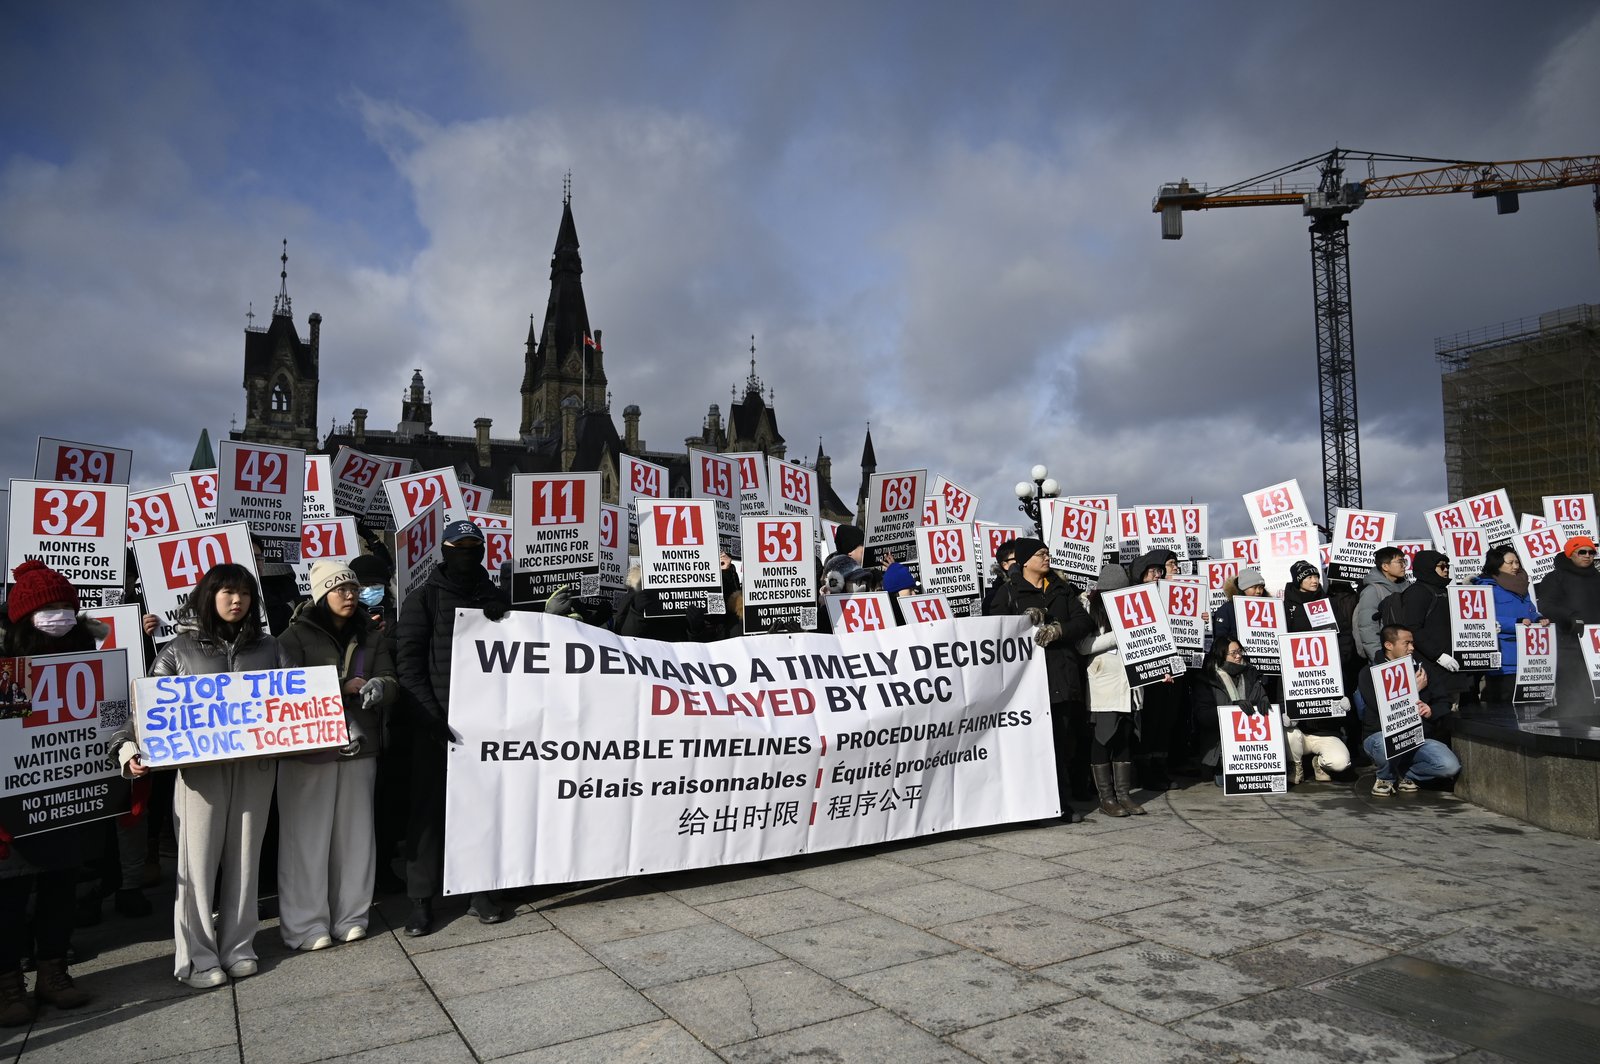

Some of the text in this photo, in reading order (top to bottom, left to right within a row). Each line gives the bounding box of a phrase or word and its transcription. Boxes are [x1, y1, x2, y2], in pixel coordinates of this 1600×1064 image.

[62, 449, 108, 483] 39
[240, 451, 281, 493] 42
[343, 457, 376, 485] 25
[338, 482, 363, 495] MONTHS
[634, 464, 657, 496] 34
[706, 460, 728, 496] 15
[785, 467, 807, 502] 53
[241, 496, 282, 508] MONTHS
[353, 494, 366, 504] FOR
[540, 482, 576, 524] 11
[885, 478, 912, 511] 68
[944, 487, 966, 517] 33
[1260, 490, 1288, 515] 43
[41, 490, 97, 535] 32
[229, 508, 291, 520] WAITING FOR
[724, 512, 735, 521] FOR
[785, 503, 808, 514] MONTHS
[882, 513, 909, 522] MONTHS
[1268, 512, 1293, 524] MONTHS
[1474, 497, 1497, 520] 27
[1558, 499, 1581, 520] 16
[660, 507, 697, 544] 71
[874, 524, 900, 533] WAITING
[1066, 509, 1092, 540] 39
[1150, 510, 1173, 534] 34
[1289, 517, 1303, 526] FOR
[1351, 516, 1380, 541] 65
[307, 525, 337, 556] 37
[411, 513, 432, 562] 31
[537, 529, 578, 540] MONTHS
[764, 523, 797, 561] 53
[869, 534, 884, 542] IRCC
[1275, 531, 1303, 554] 55
[1455, 532, 1478, 556] 72
[1488, 529, 1516, 540] RESPONSE
[1528, 532, 1557, 556] 35
[40, 541, 95, 552] MONTHS
[526, 541, 589, 554] WAITING FOR
[662, 550, 699, 559] MONTHS
[933, 531, 961, 563] 68
[1056, 550, 1095, 563] WAITING FOR
[1064, 542, 1089, 552] MONTHS
[1237, 540, 1259, 563] 30
[1339, 548, 1367, 557] WAITING
[85, 555, 109, 566] FOR
[411, 554, 432, 579] MONTHS
[520, 552, 593, 568] IRCC RESPONSE
[653, 562, 710, 572] WAITING FOR
[936, 565, 963, 575] MONTHS
[1065, 560, 1097, 572] RESPONSE
[543, 572, 584, 582] TIMELINES
[649, 573, 716, 584] IRCC RESPONSE
[763, 567, 797, 576] MONTHS
[930, 575, 970, 585] WAITING FOR
[754, 578, 806, 588] WAITING FOR
[943, 584, 975, 593] RESPONSE
[671, 591, 708, 599] TIMELINES
[750, 589, 811, 600] IRCC RESPONSE
[1172, 587, 1195, 615] 33
[1462, 591, 1484, 618] 34
[663, 601, 673, 610] NO
[846, 599, 880, 632] 34
[1123, 593, 1151, 626] 41
[1249, 602, 1274, 627] 24
[1126, 634, 1166, 649] WAITING FOR
[1130, 626, 1157, 638] MONTHS
[1528, 629, 1547, 655] 35
[475, 637, 1033, 687] WE DEMAND A TIMELY DECISION
[1125, 643, 1172, 660] IRCC RESPONSE
[1296, 638, 1324, 666] 40
[1145, 659, 1170, 670] TIMELINES
[1298, 670, 1326, 678] MONTHS
[32, 663, 96, 722] 40
[157, 670, 306, 705] STOP THE
[1292, 678, 1319, 687] WAITING
[1305, 686, 1339, 694] RESPONSE
[1385, 665, 1408, 699] 22
[651, 676, 952, 717] DELAYED BY IRCC
[1390, 699, 1409, 711] MONTHS
[1387, 706, 1415, 722] WAITING FOR
[1396, 714, 1419, 728] RESPONSE
[247, 720, 348, 750] TOGETHER
[481, 710, 1032, 761] REASONABLE TIMELINES PROCEDURAL FAIRNESS
[1237, 711, 1266, 740] 43
[31, 727, 96, 749] MONTHS
[14, 747, 80, 770] WAITING
[1232, 753, 1261, 761] WAITING
[1245, 761, 1281, 769] RESPONSE
[5, 771, 41, 790] IRCC
[558, 745, 988, 800] Délais raisonnables Équité procédurale
[22, 784, 108, 810] NO TIMELINES
[29, 799, 104, 824] NO RESULTS
[678, 785, 922, 836] 给出时限 程序公平
